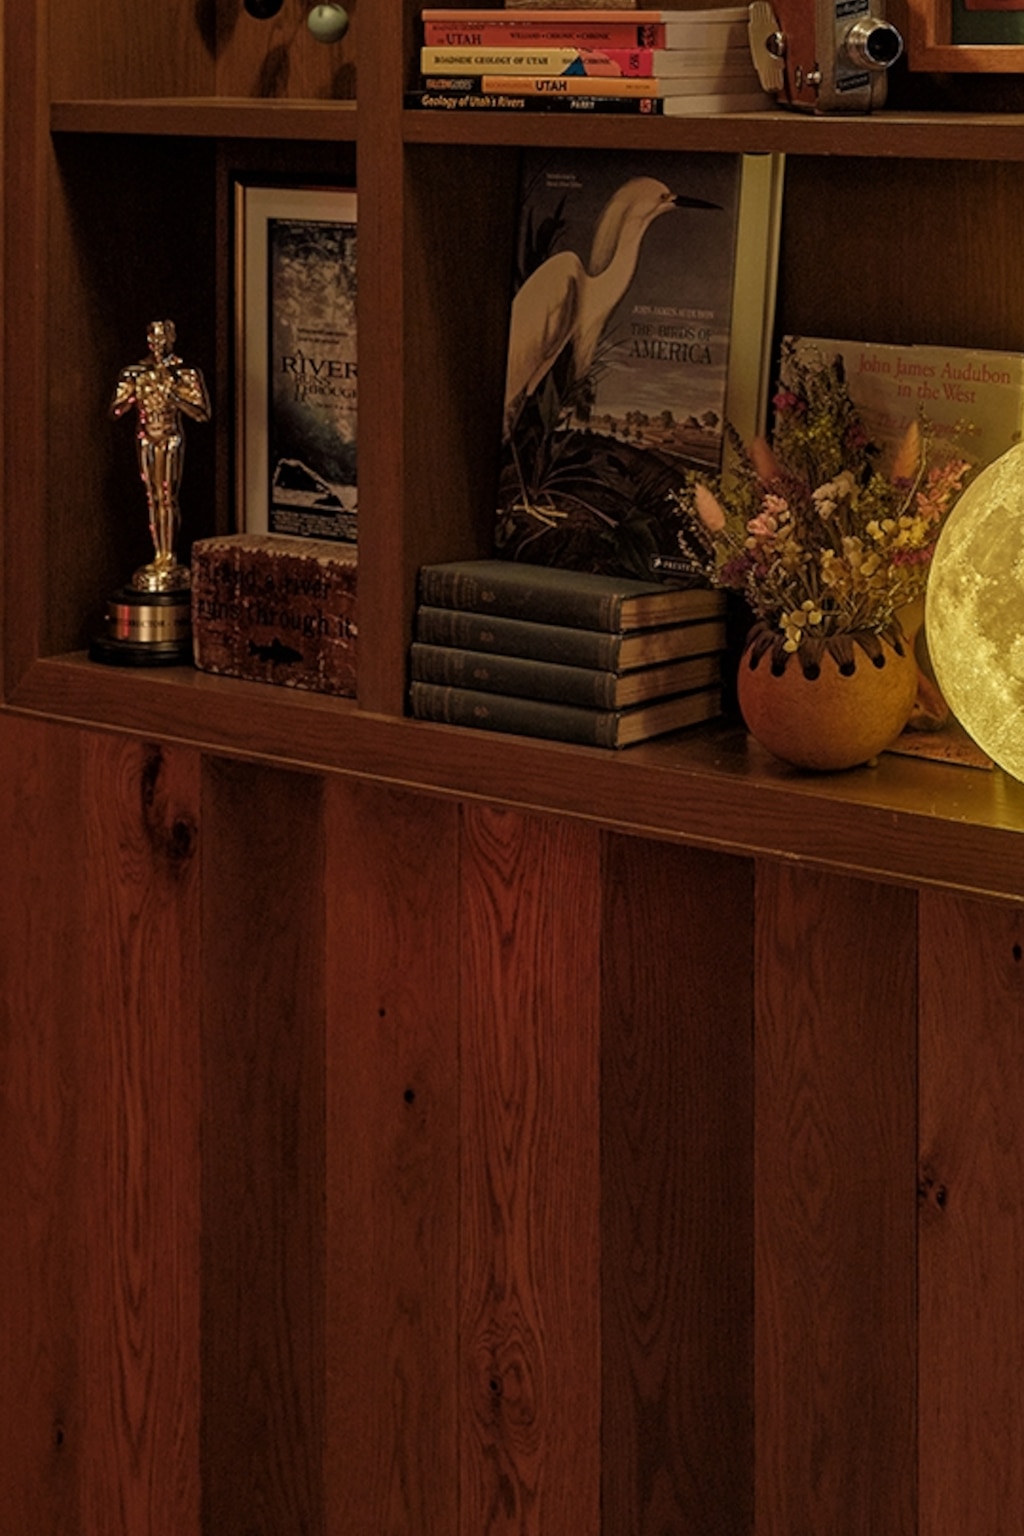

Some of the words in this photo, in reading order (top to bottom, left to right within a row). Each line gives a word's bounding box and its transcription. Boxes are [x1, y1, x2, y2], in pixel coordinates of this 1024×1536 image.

[446, 33, 482, 45] UTAH
[434, 56, 472, 65] ROADSIDE
[474, 56, 511, 65] GEOLOGY
[526, 57, 549, 65] UTAH
[535, 80, 568, 91] UTAH
[422, 94, 457, 109] Geology
[458, 95, 470, 107] of
[498, 96, 525, 108] Rivers
[631, 322, 653, 337] THE
[658, 324, 695, 339] BIRDS
[698, 327, 712, 341] OF
[629, 339, 712, 364] AMERICA
[281, 355, 358, 379] RIVER
[857, 354, 890, 374] John
[895, 356, 935, 378] James
[940, 362, 1011, 385] Audubon
[897, 381, 911, 396] in
[916, 381, 940, 400] the
[943, 382, 977, 404] West
